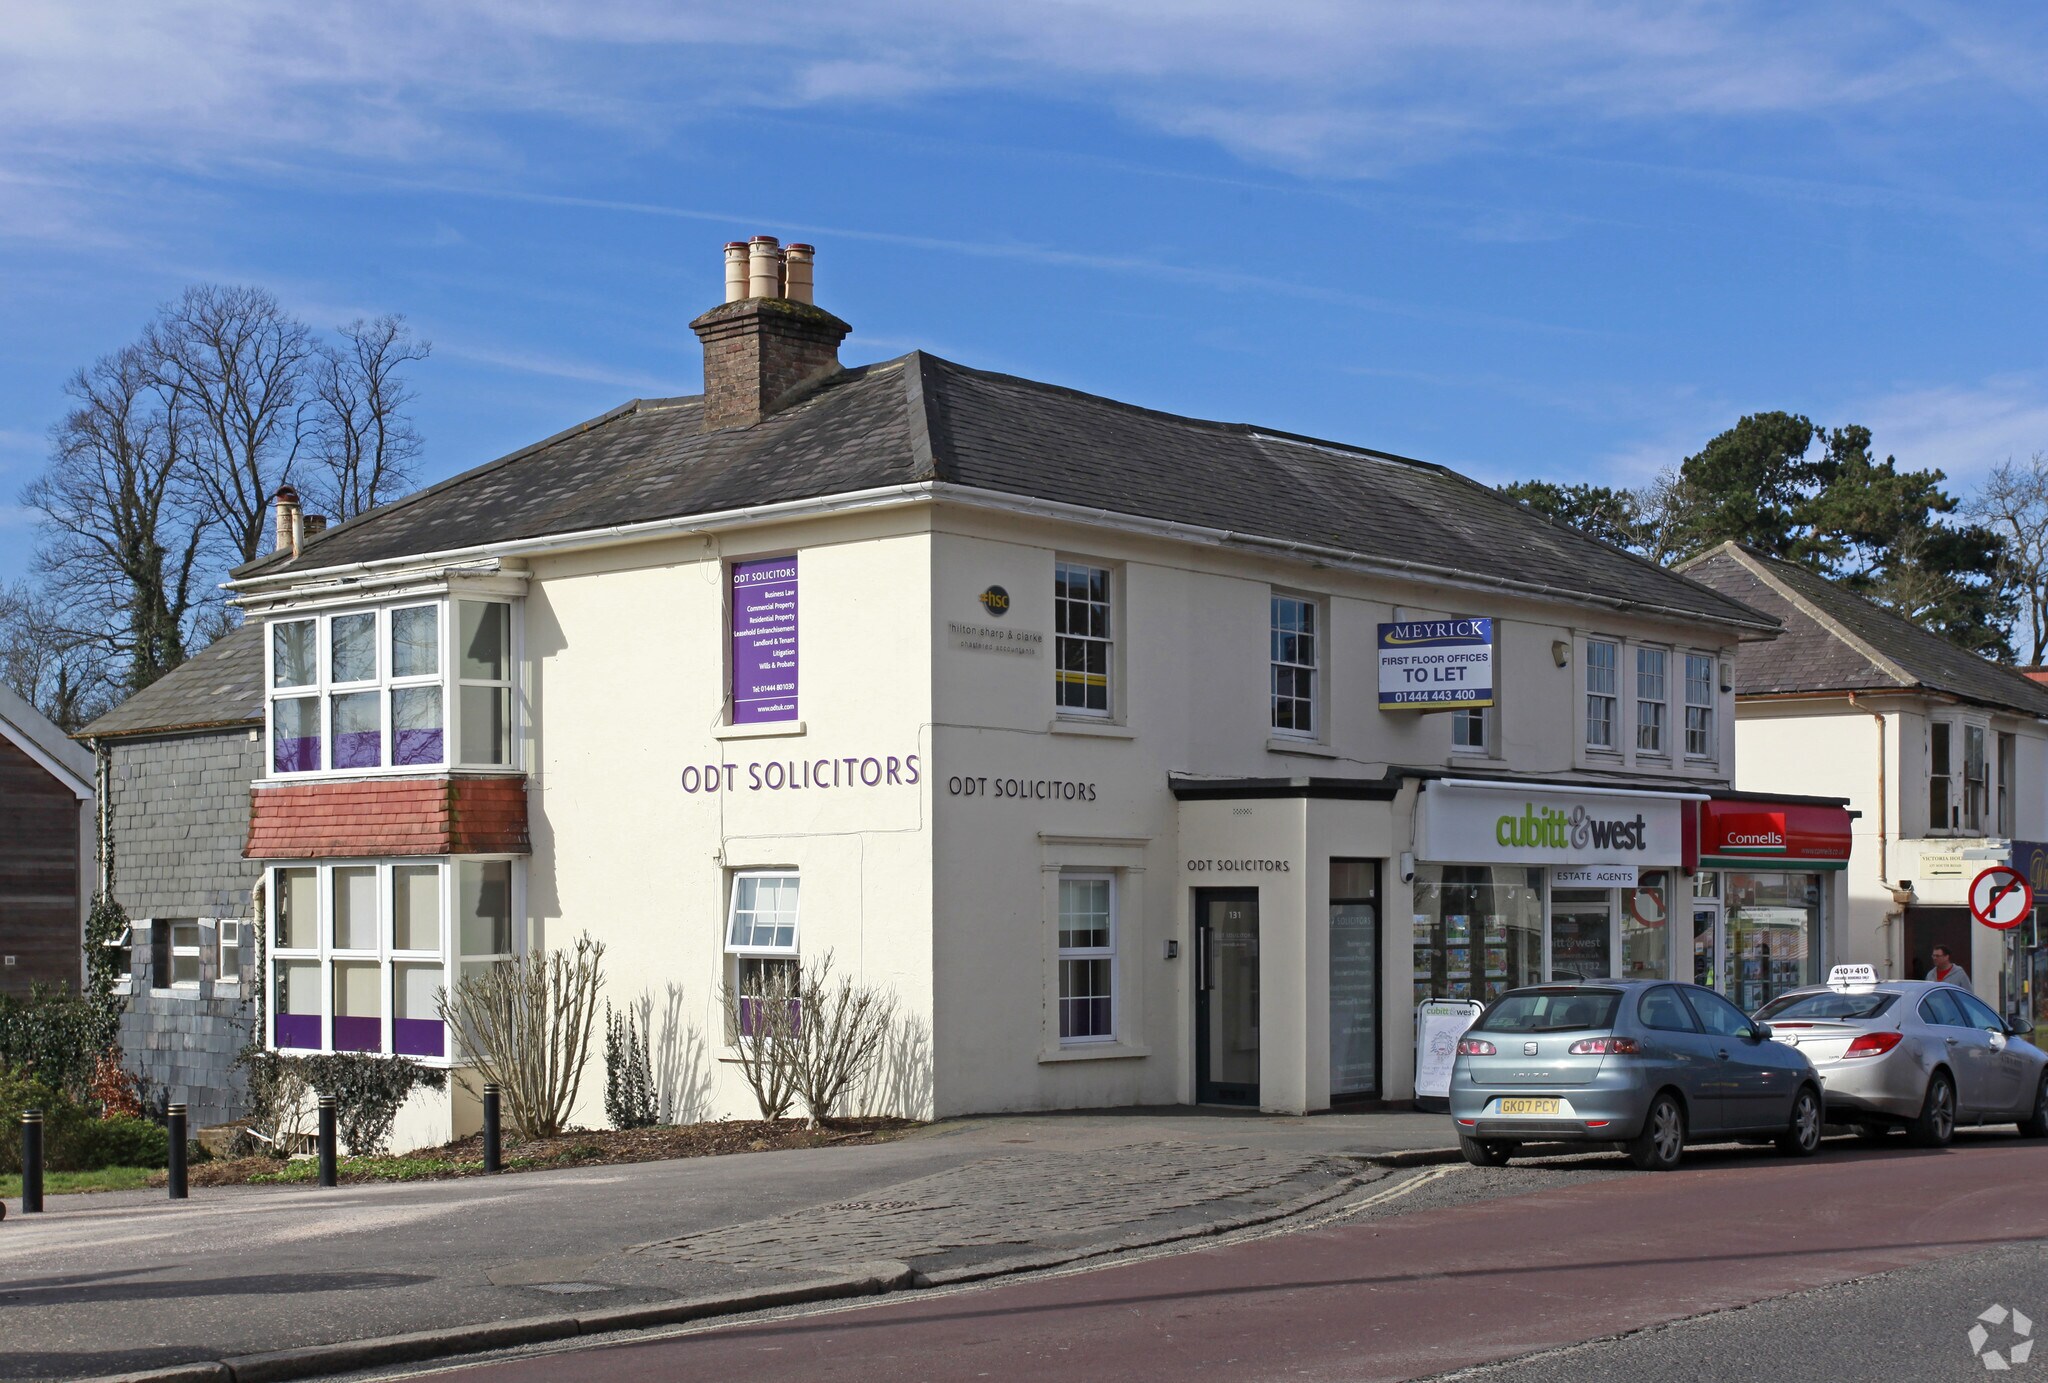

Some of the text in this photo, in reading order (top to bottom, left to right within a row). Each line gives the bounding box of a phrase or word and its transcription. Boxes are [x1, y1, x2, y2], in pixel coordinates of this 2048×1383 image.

[733, 568, 796, 583] ODT SOLICITORS
[988, 591, 1009, 608] hsc
[746, 602, 795, 612] Commercial Property
[749, 614, 795, 623] Residential Property
[733, 626, 795, 637] Leasehold Enfranchisement
[980, 627, 1004, 639] sharp
[1007, 630, 1013, 640] &
[1016, 632, 1043, 642] clarke
[1394, 621, 1484, 639] MEYRICK
[753, 639, 773, 647] Landlord
[772, 649, 796, 658] Litigation
[1381, 653, 1489, 665] FIRST FLOOR OFFICES
[1403, 666, 1467, 683] TO LET
[1395, 689, 1476, 702] 01444 443 400
[681, 755, 921, 793] ODT SOLICITORS
[949, 776, 1097, 802] ODT SOLICITORS
[1496, 802, 1646, 850] cubitt & west
[1727, 832, 1783, 845] Connells
[1187, 860, 1290, 872] ODT SOLICITORS
[1557, 872, 1633, 881] ESTATE AGENTS
[1228, 911, 1241, 919] 131
[1575, 937, 1601, 948] west
[1426, 1007, 1449, 1015] cubitt
[1456, 1008, 1475, 1016] west
[1503, 1100, 1558, 1112] GK07 PCY
